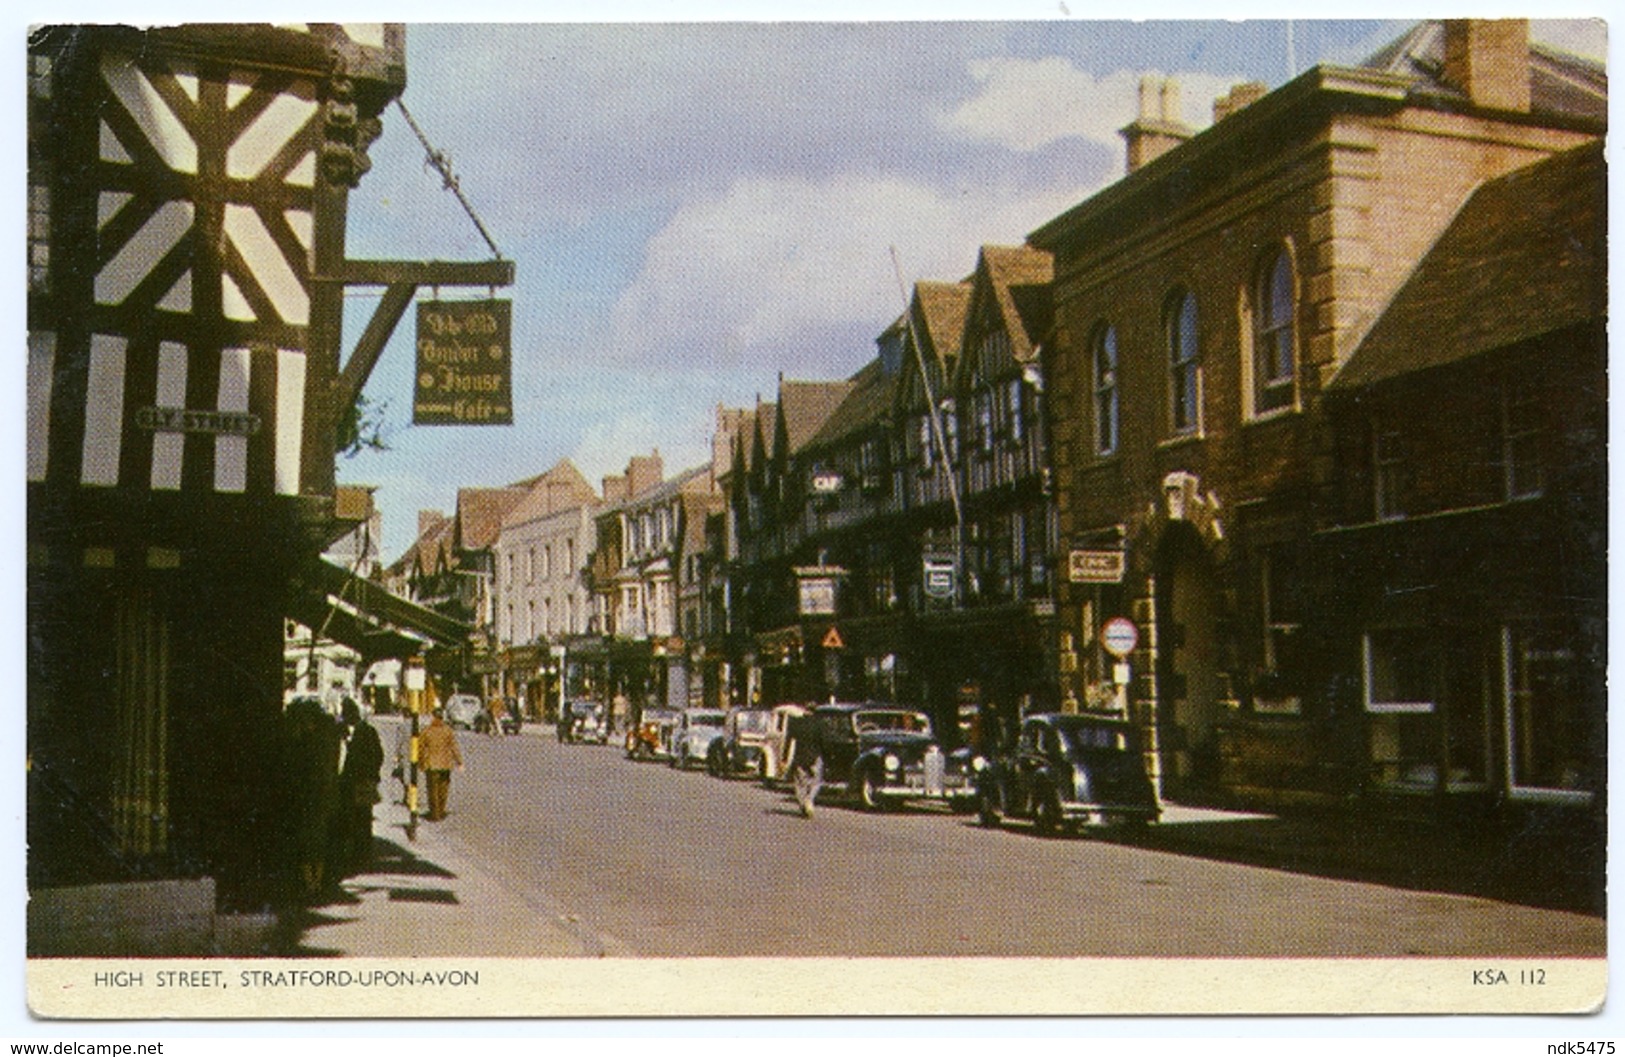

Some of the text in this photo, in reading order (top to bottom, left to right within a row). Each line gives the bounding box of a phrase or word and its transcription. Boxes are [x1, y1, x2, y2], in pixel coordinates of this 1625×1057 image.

[465, 313, 498, 335] Old
[417, 338, 480, 362] Tudor
[437, 365, 502, 392] House
[186, 413, 260, 433] STREET
[94, 970, 480, 989] HIGH STREET, STRATFORD-UPON-AVON
[1473, 969, 1509, 986] KSA
